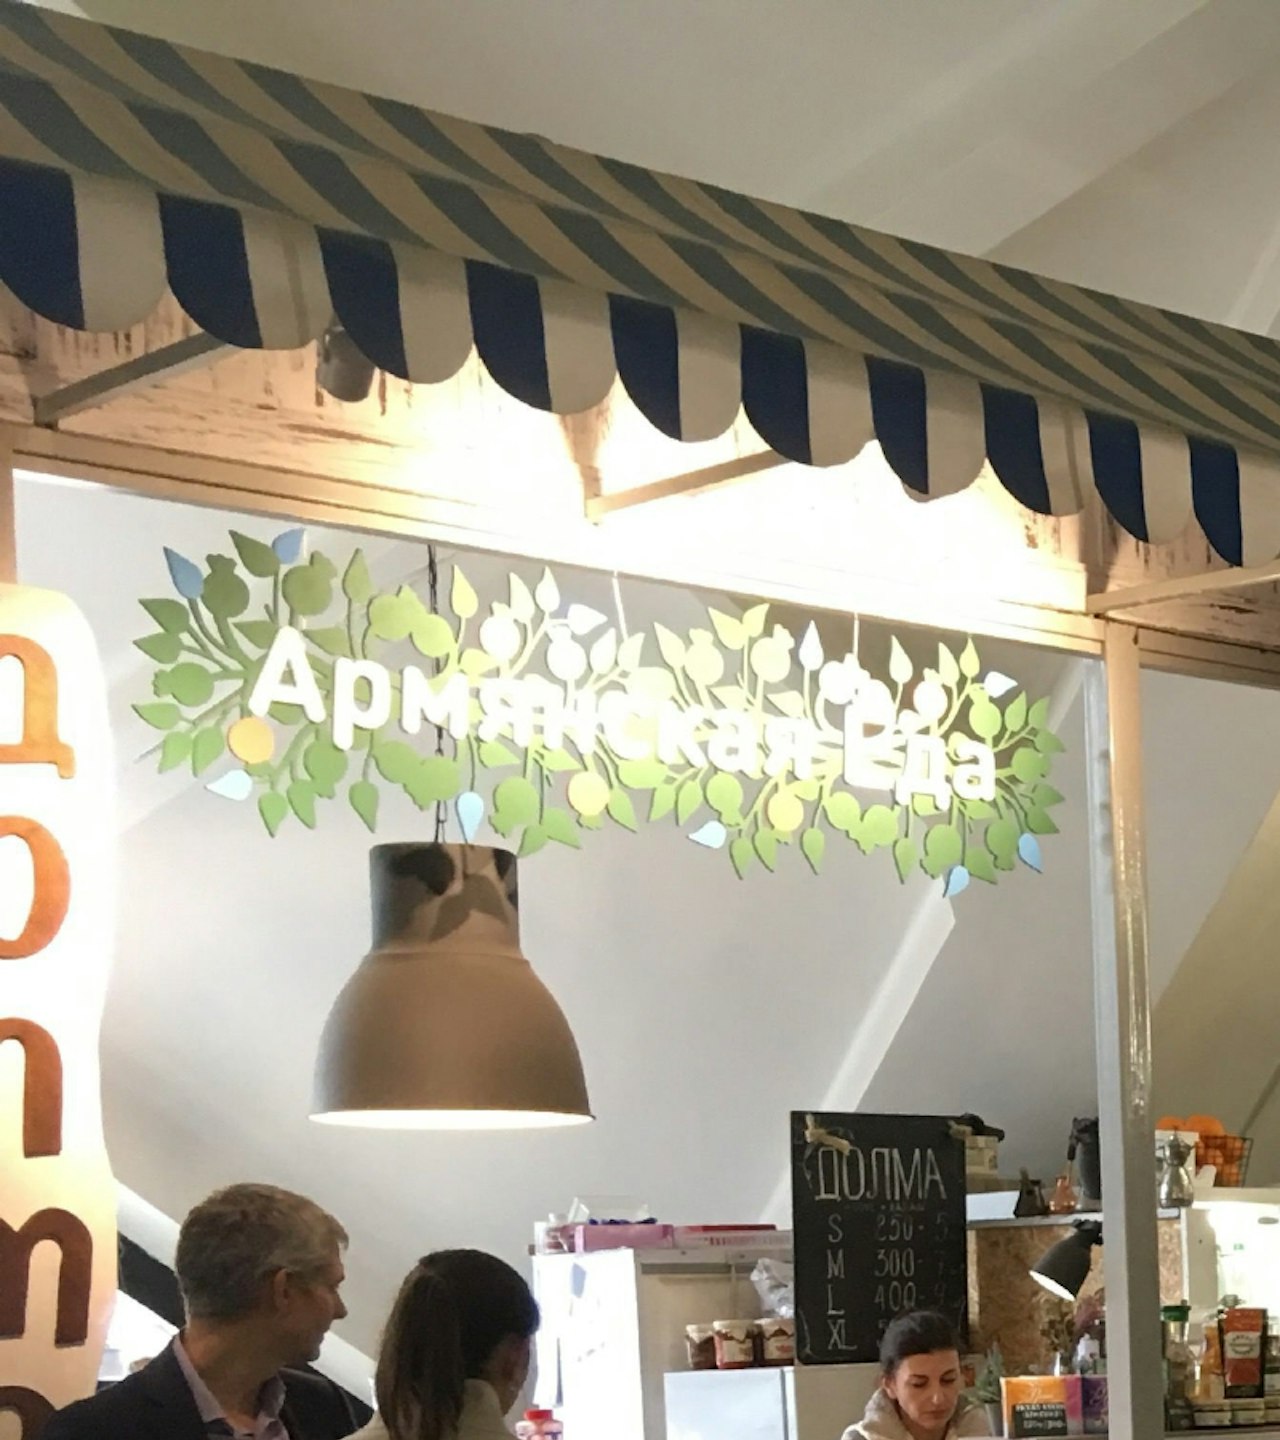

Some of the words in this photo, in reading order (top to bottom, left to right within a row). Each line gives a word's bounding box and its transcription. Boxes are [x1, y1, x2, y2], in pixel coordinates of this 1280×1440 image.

[247, 625, 814, 780] Армянская
[815, 1147, 948, 1202] ДОЛМА
[827, 1213, 844, 1244] S
[826, 1248, 845, 1280] M
[827, 1283, 846, 1315] L
[827, 1318, 858, 1350] XL
